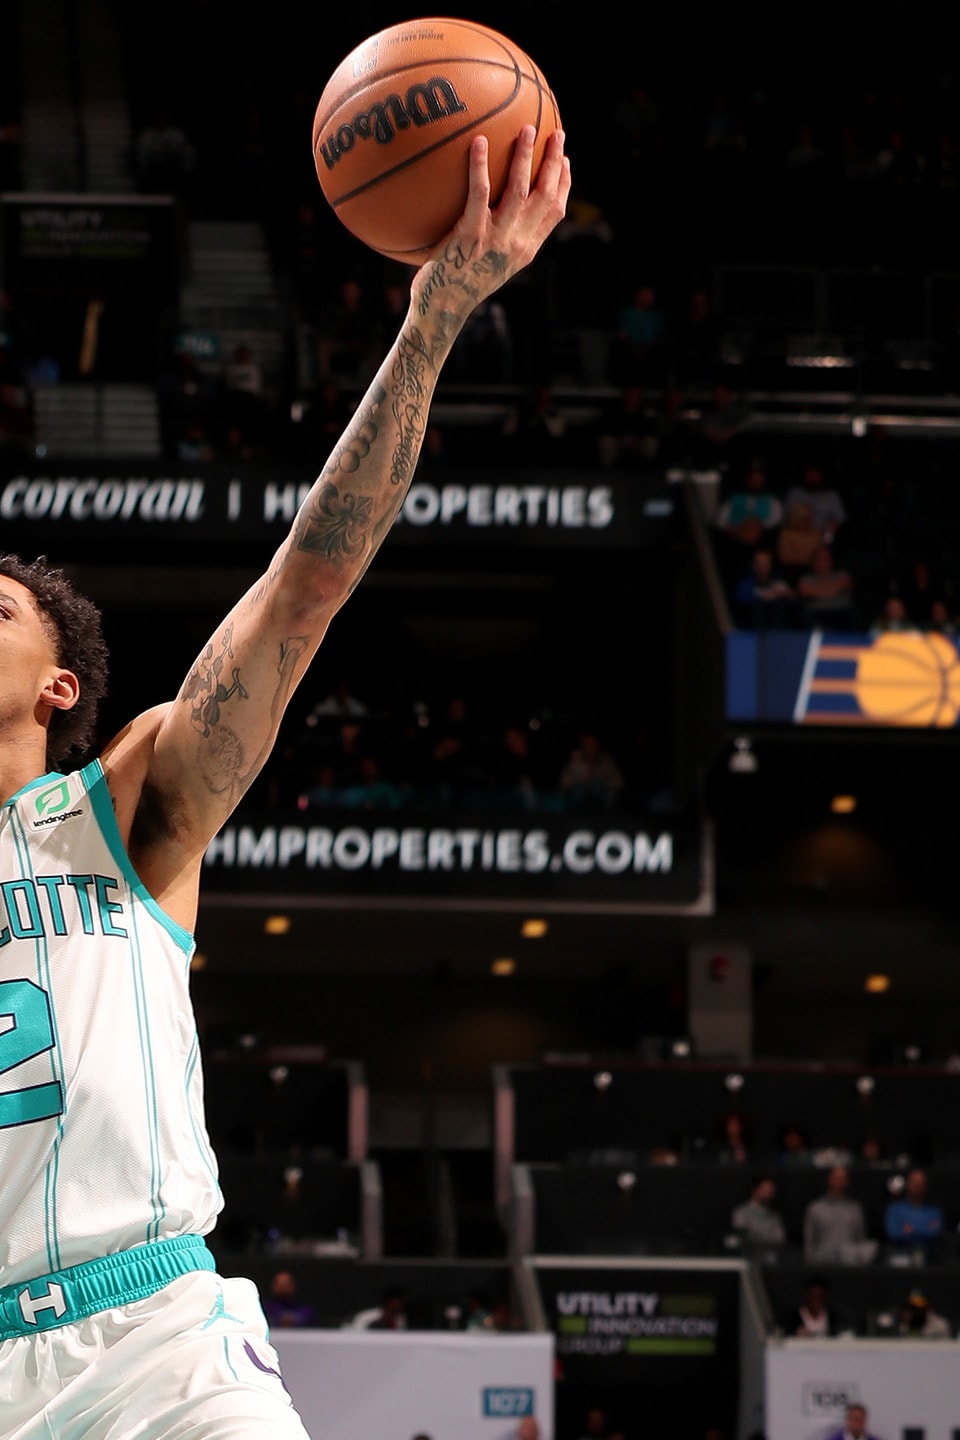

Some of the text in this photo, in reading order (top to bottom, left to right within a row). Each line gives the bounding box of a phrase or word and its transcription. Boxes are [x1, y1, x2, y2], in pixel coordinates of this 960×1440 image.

[320, 77, 467, 171] Wilson
[0, 478, 204, 521] corcoran
[33, 809, 83, 828] lendingtree
[203, 827, 673, 873] HMPROPERTIES.COM
[556, 1291, 660, 1316] UTILITY
[589, 1315, 719, 1337] INNOVATION
[489, 1391, 530, 1414] 107
